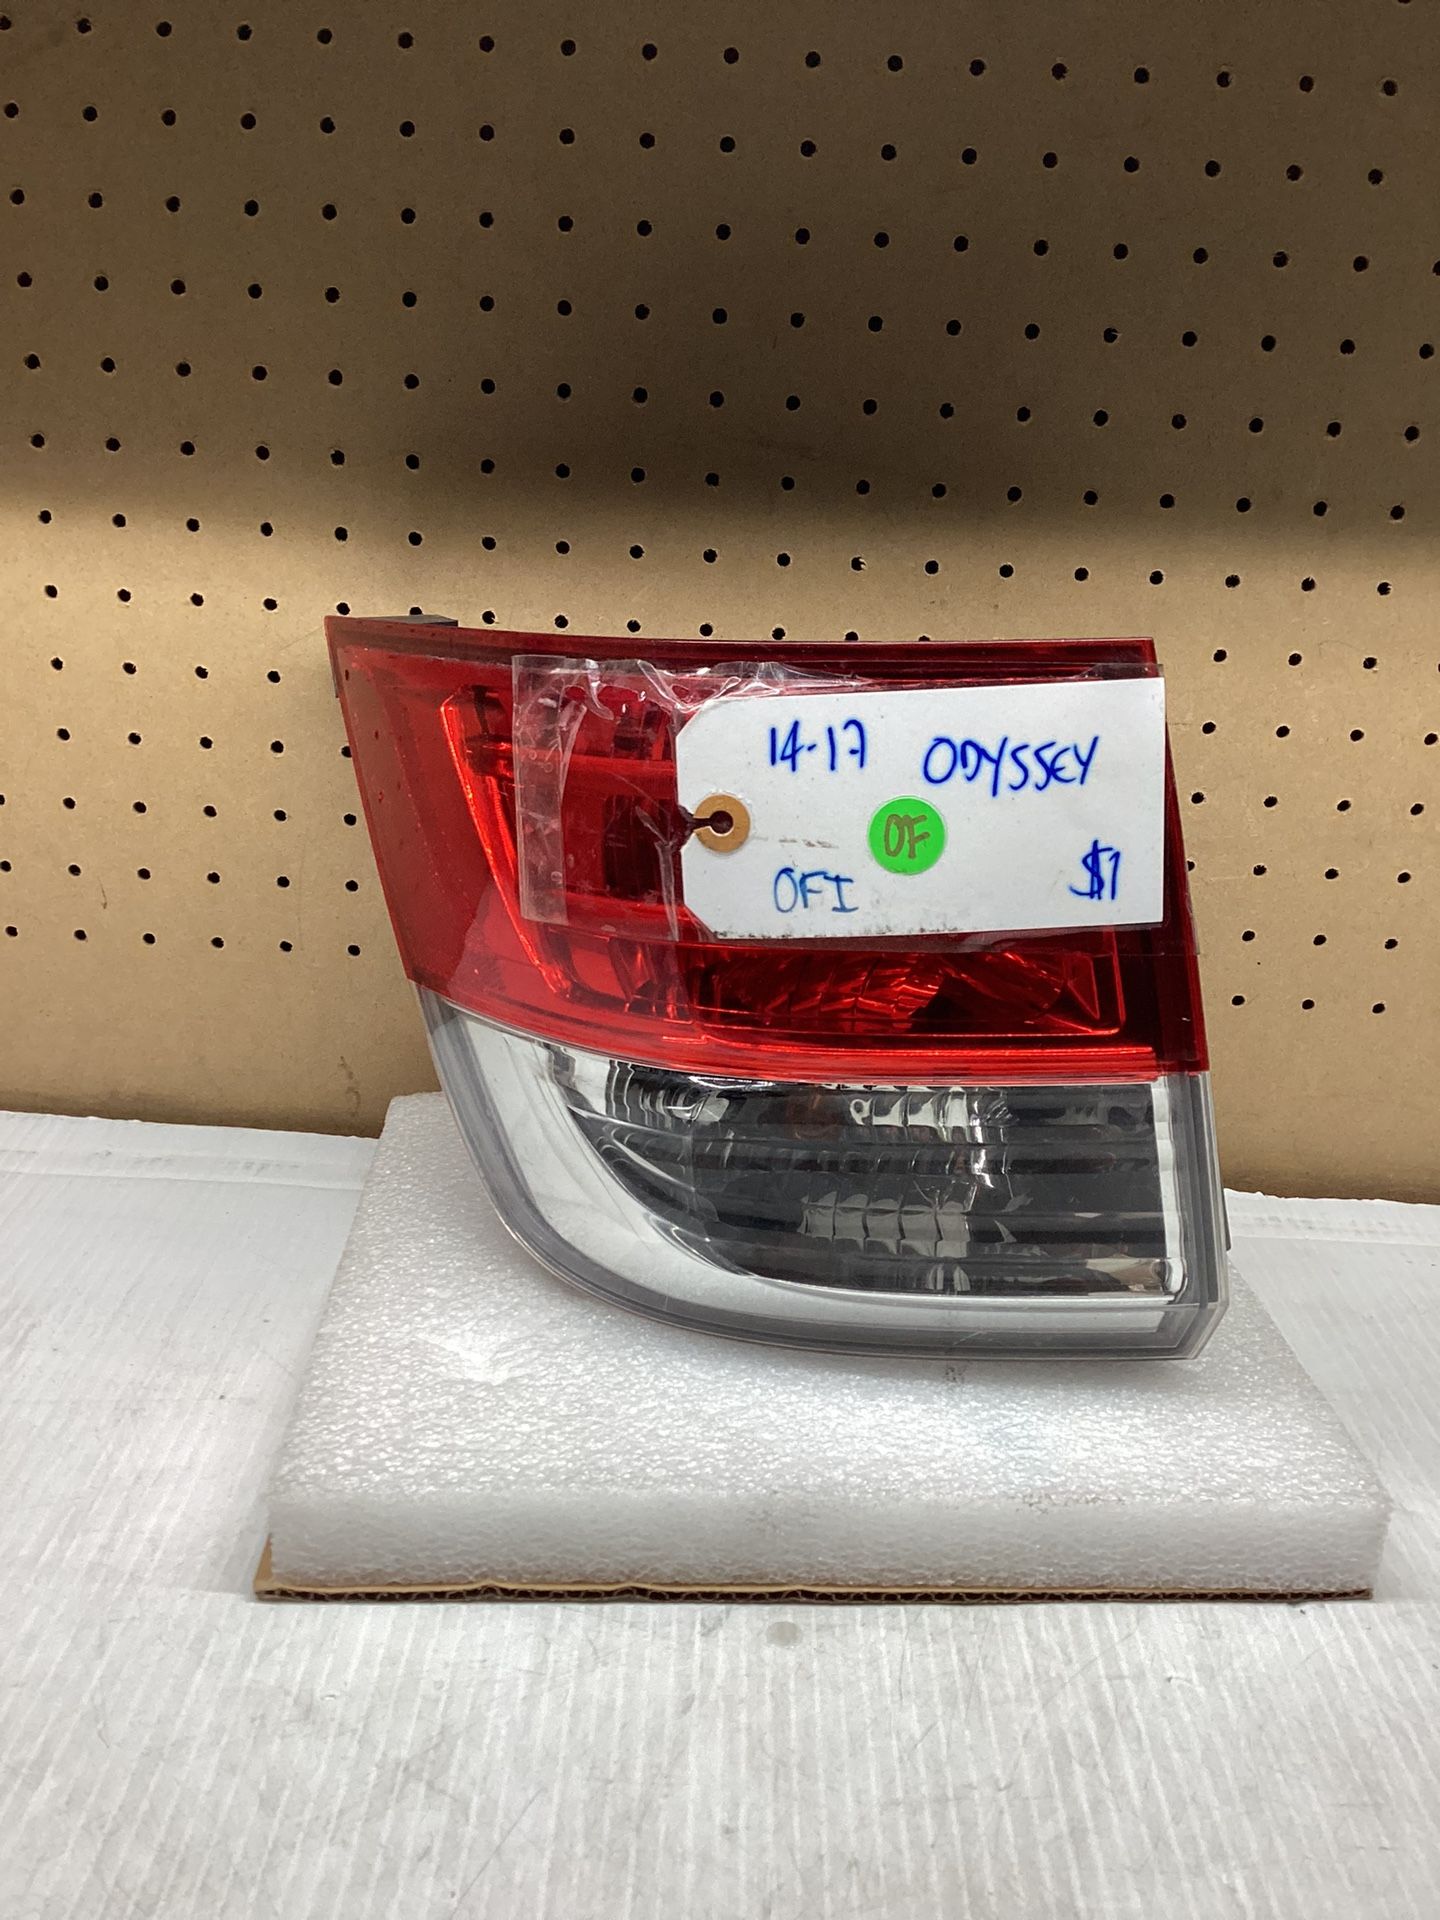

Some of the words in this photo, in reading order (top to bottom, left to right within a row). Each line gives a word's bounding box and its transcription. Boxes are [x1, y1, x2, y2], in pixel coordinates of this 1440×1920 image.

[769, 718, 867, 773] 14-17
[922, 735, 1099, 798] ODYSSEY
[883, 812, 931, 860] OF
